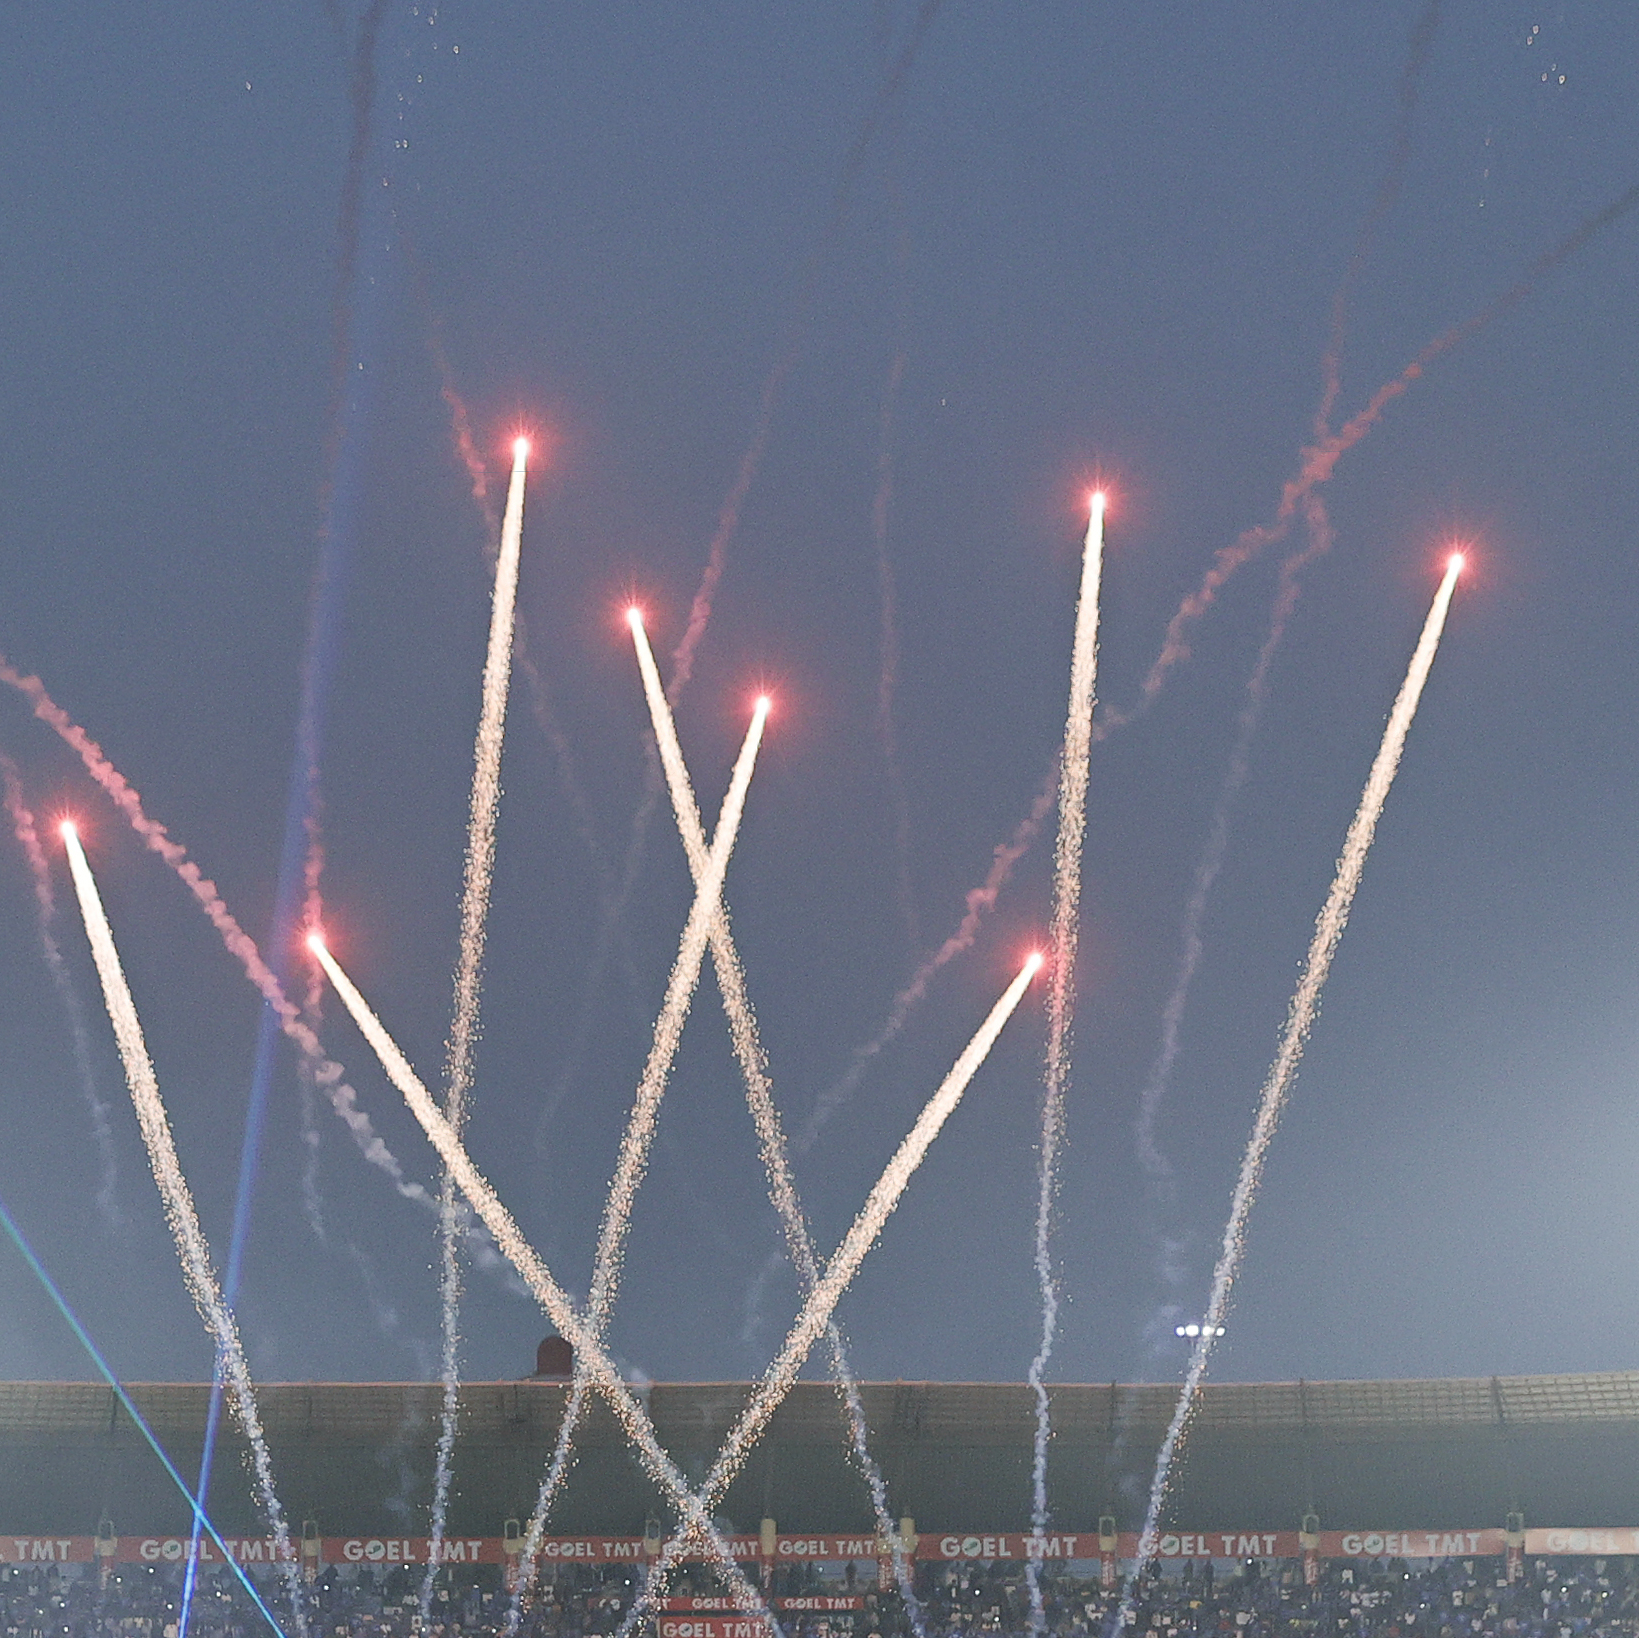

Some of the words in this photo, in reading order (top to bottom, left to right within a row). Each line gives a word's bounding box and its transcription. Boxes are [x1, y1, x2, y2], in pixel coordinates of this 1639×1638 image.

[15, 1540, 72, 1560] TMT
[140, 1539, 213, 1561] GOEL
[225, 1540, 287, 1561] TMT
[343, 1540, 415, 1561] GOEL
[426, 1540, 483, 1561] TMT
[545, 1540, 595, 1557] GOEL
[602, 1540, 646, 1558] TMT
[778, 1539, 829, 1556] GOEL
[835, 1539, 875, 1556] TMT
[940, 1535, 1012, 1558] GOEL
[1022, 1536, 1078, 1557] TMT
[1139, 1535, 1211, 1557] GOEL
[1221, 1535, 1278, 1556] TMT
[1342, 1533, 1415, 1555] GOEL
[1424, 1533, 1482, 1554] TMT
[1546, 1531, 1619, 1552] GOEL
[692, 1597, 729, 1610] GOEL
[784, 1597, 823, 1610] GOEL
[825, 1597, 856, 1610] TMT
